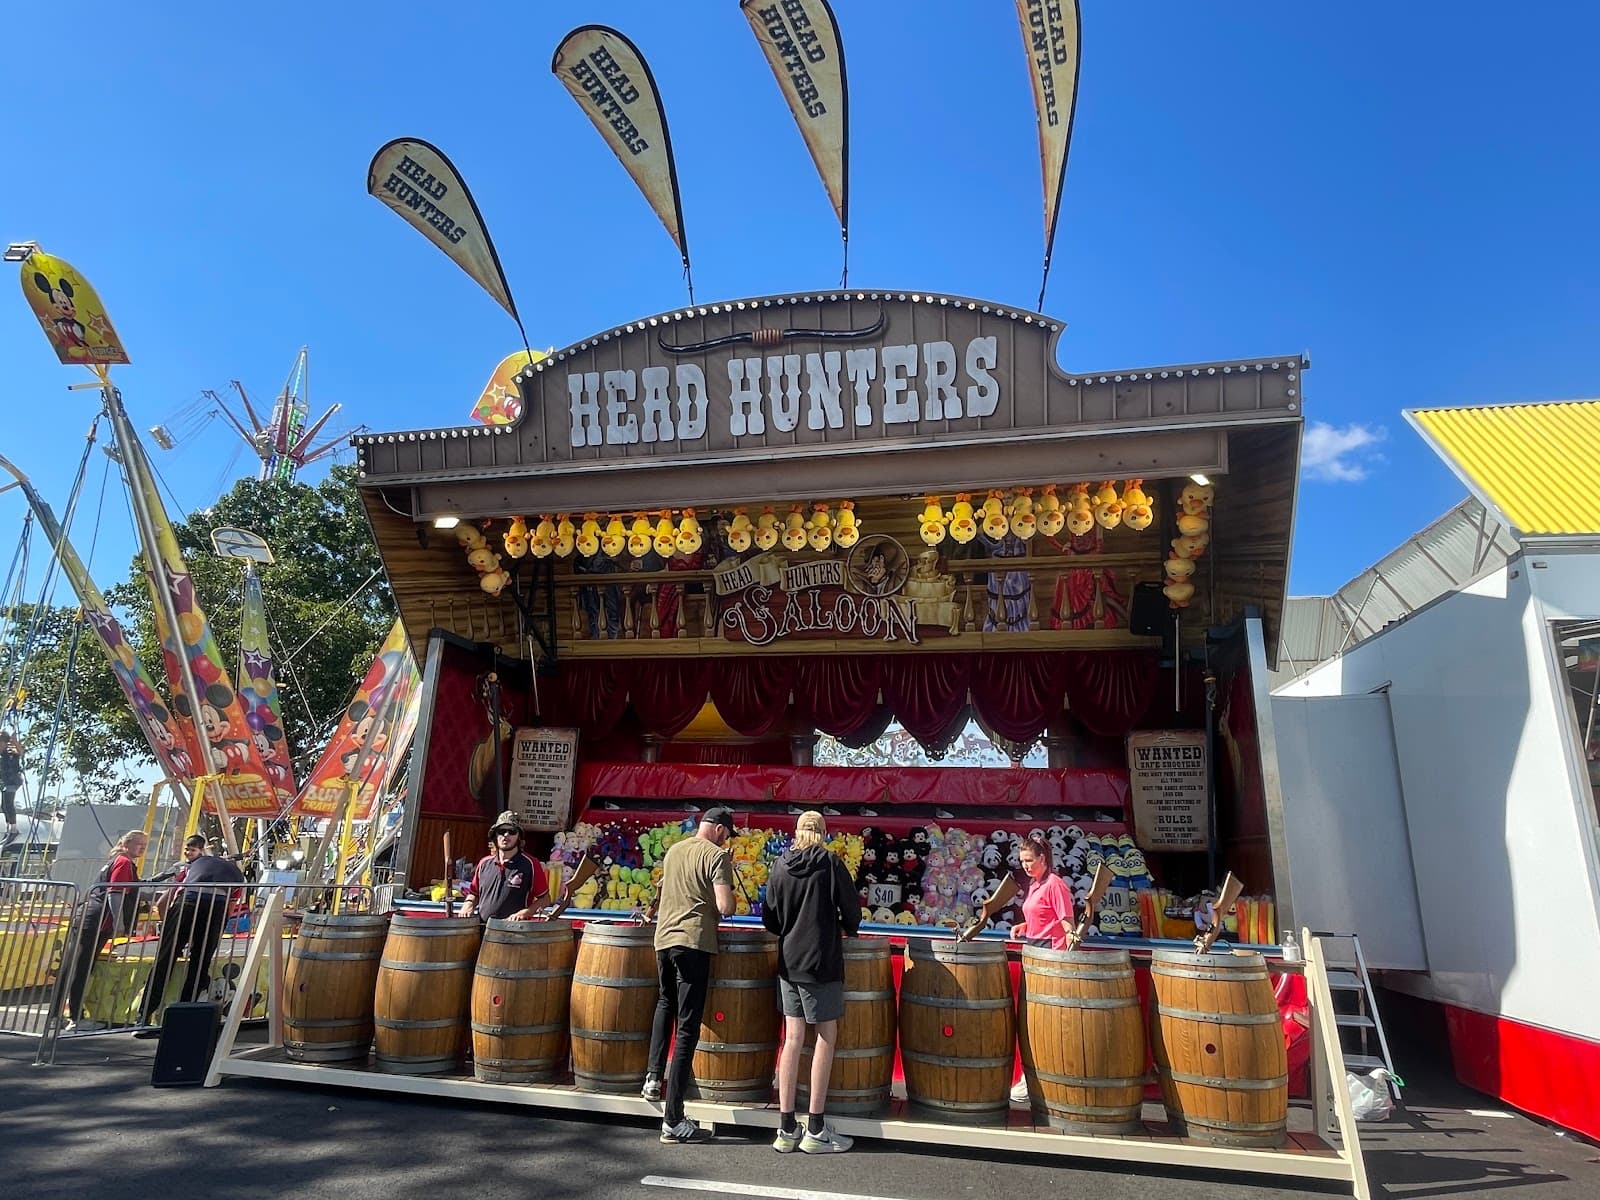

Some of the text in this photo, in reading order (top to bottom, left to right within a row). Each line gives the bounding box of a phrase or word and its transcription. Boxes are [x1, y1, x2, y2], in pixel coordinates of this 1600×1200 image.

[758, 4, 827, 118] HUNTERS
[781, 0, 826, 63] HEAD
[1045, 0, 1067, 65] EAD
[588, 44, 640, 105] HEAD
[568, 58, 650, 156] HUNTERS
[395, 154, 448, 201] HEAD
[382, 172, 468, 245] HUNTERS
[567, 336, 1000, 448] HEAD HUNTERS
[720, 561, 842, 591] HEAD HUNTERS
[722, 584, 920, 646] SALOON
[521, 741, 569, 754] WANTED
[1136, 746, 1202, 761] WANTED
[527, 799, 553, 808] RULES
[1158, 815, 1193, 824] RULES
[874, 886, 894, 904] $40
